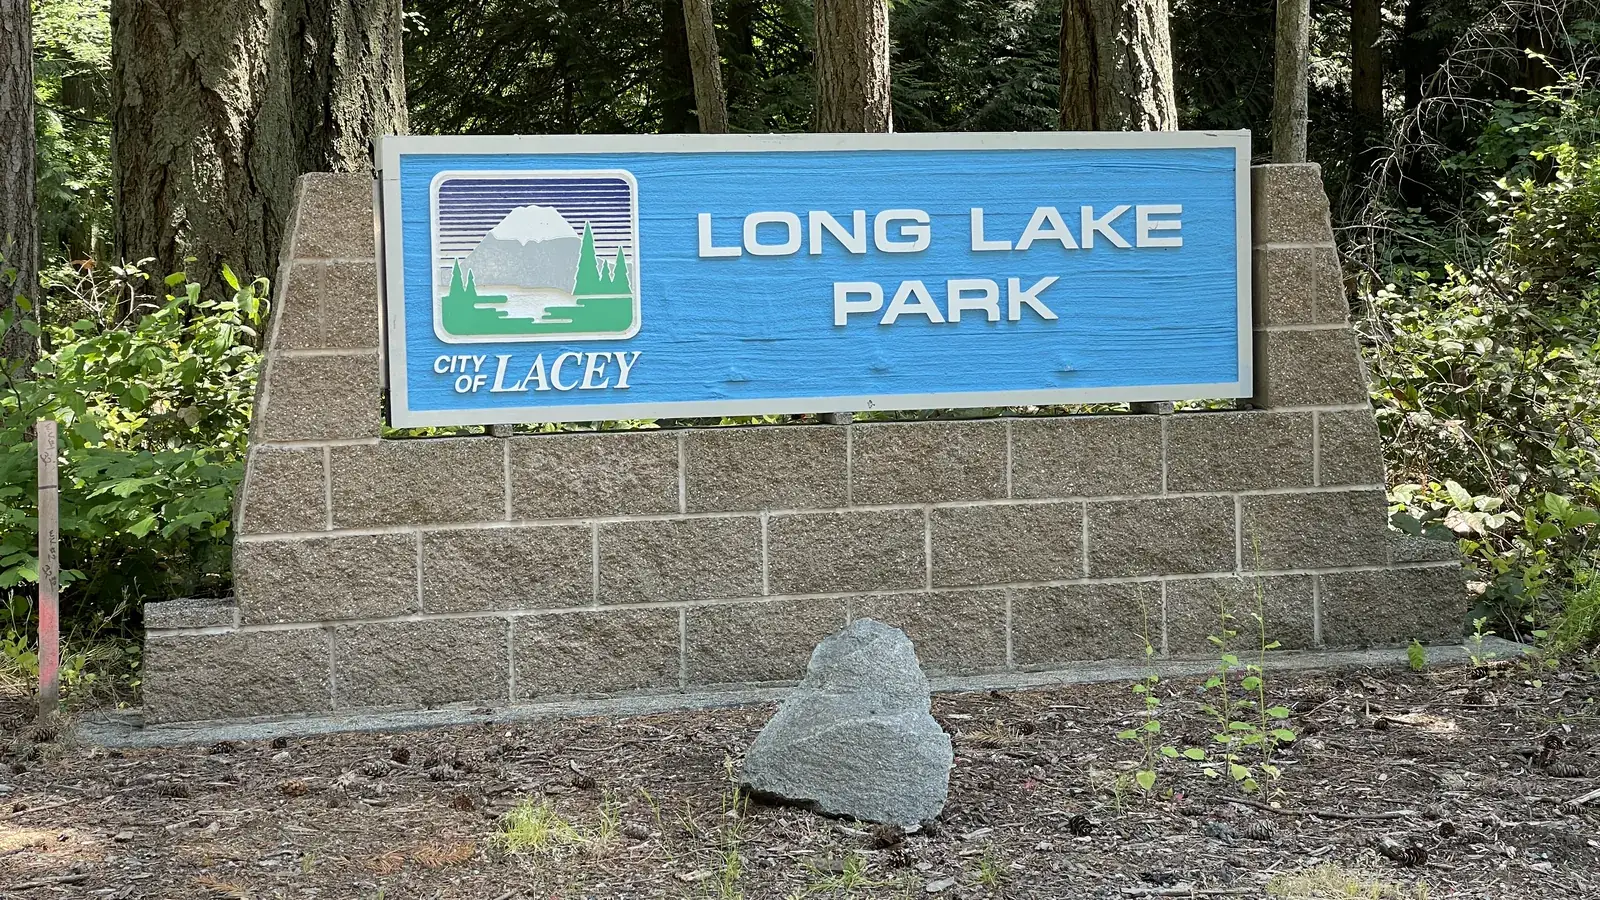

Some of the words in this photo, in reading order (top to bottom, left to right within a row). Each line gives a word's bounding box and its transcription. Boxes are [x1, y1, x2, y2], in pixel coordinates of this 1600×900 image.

[697, 209, 931, 258] LONG
[970, 203, 1184, 251] LAKE
[833, 275, 1060, 327] PARK
[433, 355, 487, 374] CITY
[454, 374, 487, 393] OF
[490, 350, 642, 393] LACEY
